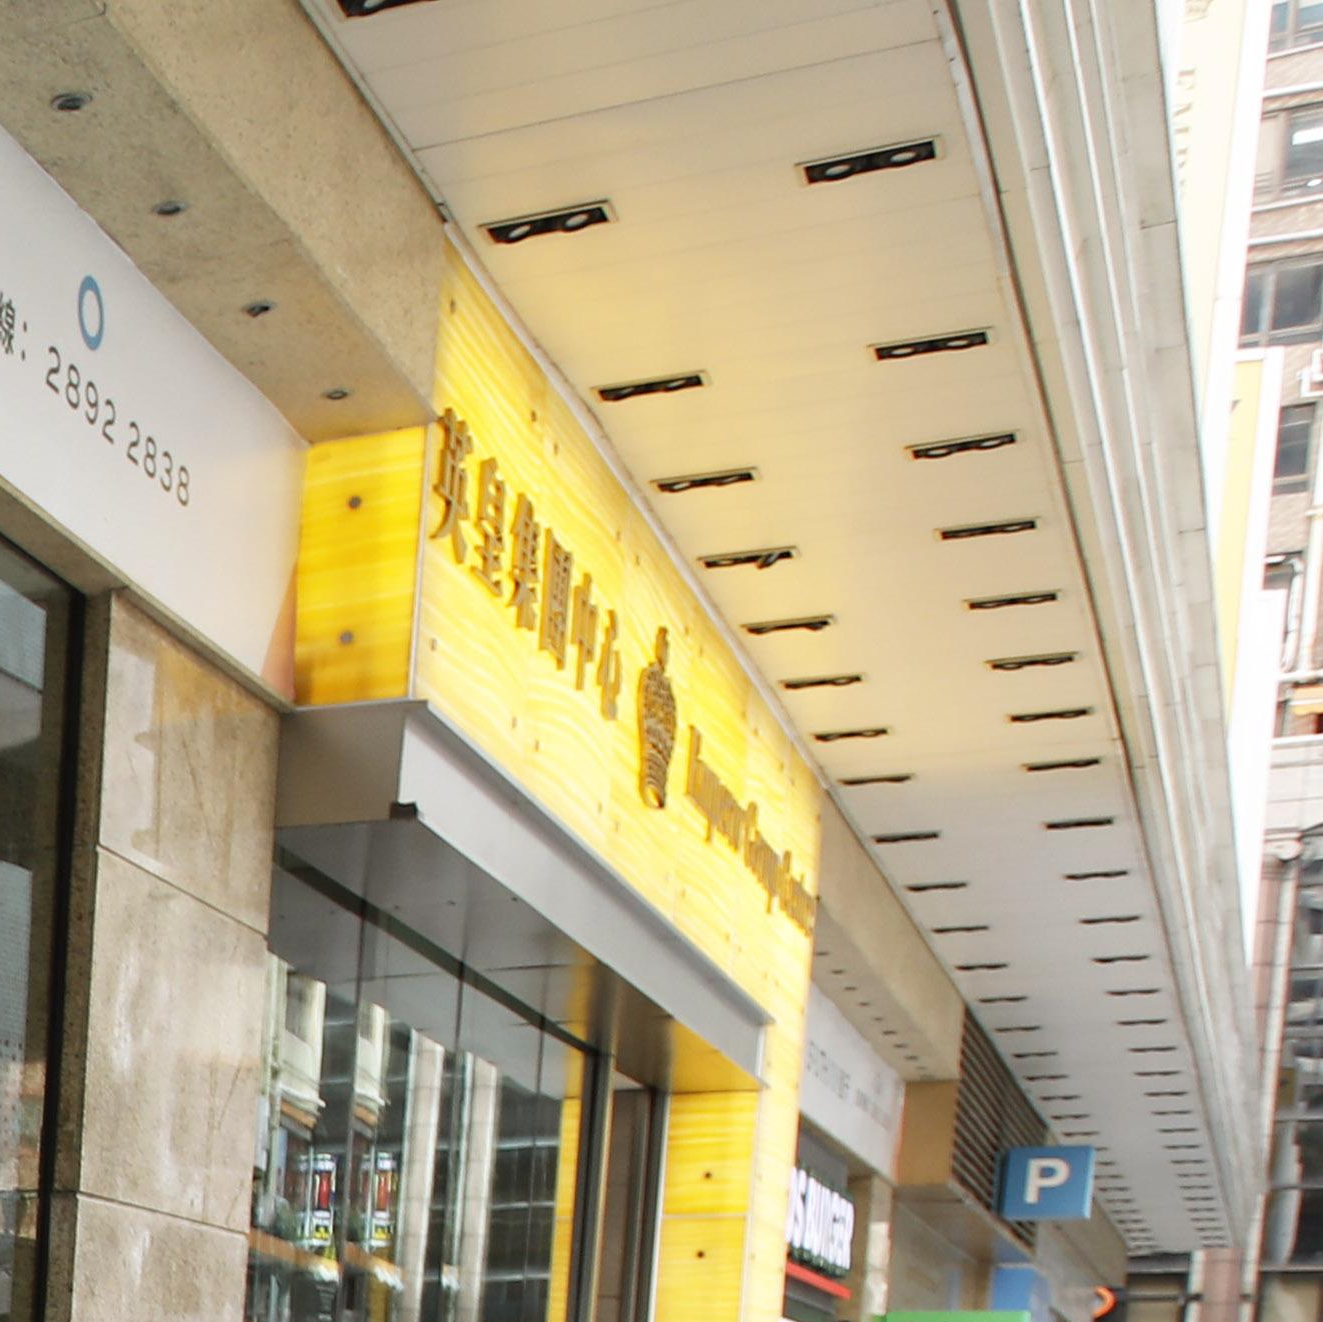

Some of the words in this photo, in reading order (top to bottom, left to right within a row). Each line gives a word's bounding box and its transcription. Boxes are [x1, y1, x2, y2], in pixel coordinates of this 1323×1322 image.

[46, 346, 117, 446] 2892
[126, 421, 190, 508] 2838
[1025, 1157, 1071, 1204] P
